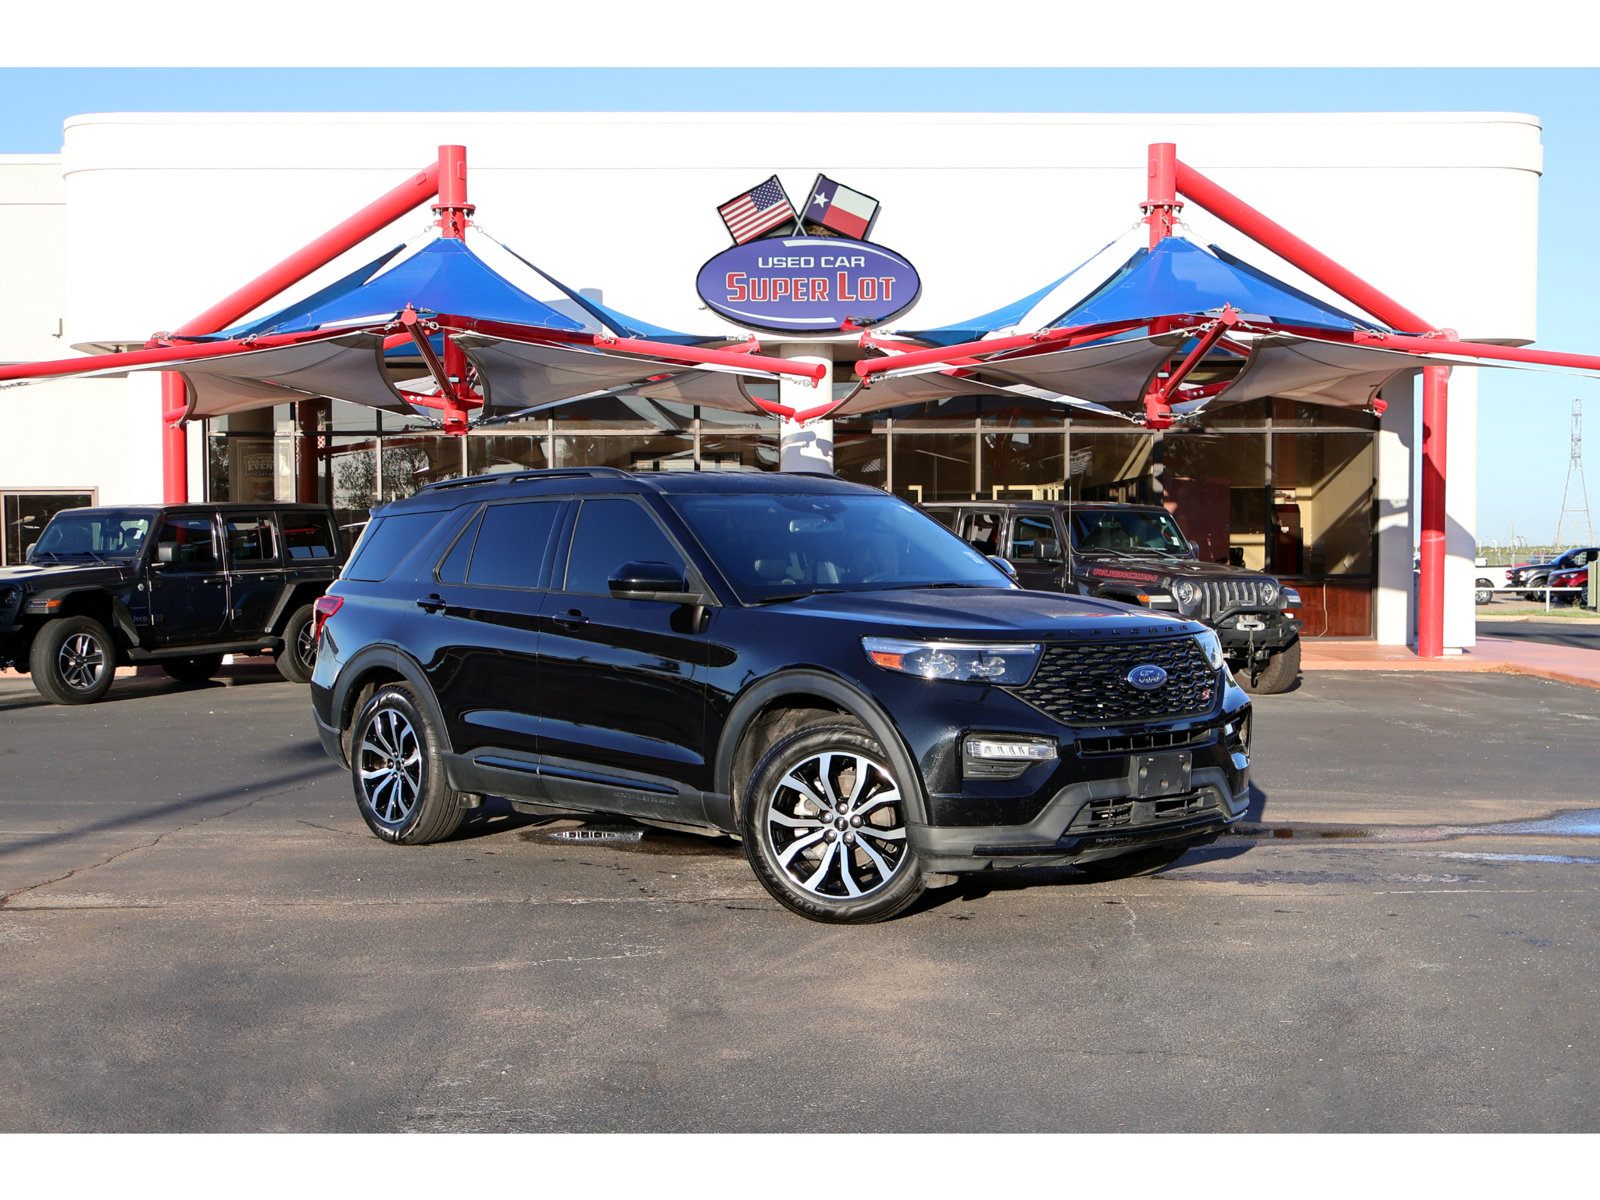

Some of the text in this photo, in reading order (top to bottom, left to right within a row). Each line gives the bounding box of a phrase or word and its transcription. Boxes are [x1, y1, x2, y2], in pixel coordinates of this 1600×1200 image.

[758, 256, 865, 268] USED CAR
[725, 271, 896, 302] SUPER LOT
[1092, 568, 1159, 582] RUBICON
[1138, 669, 1160, 683] Ford
